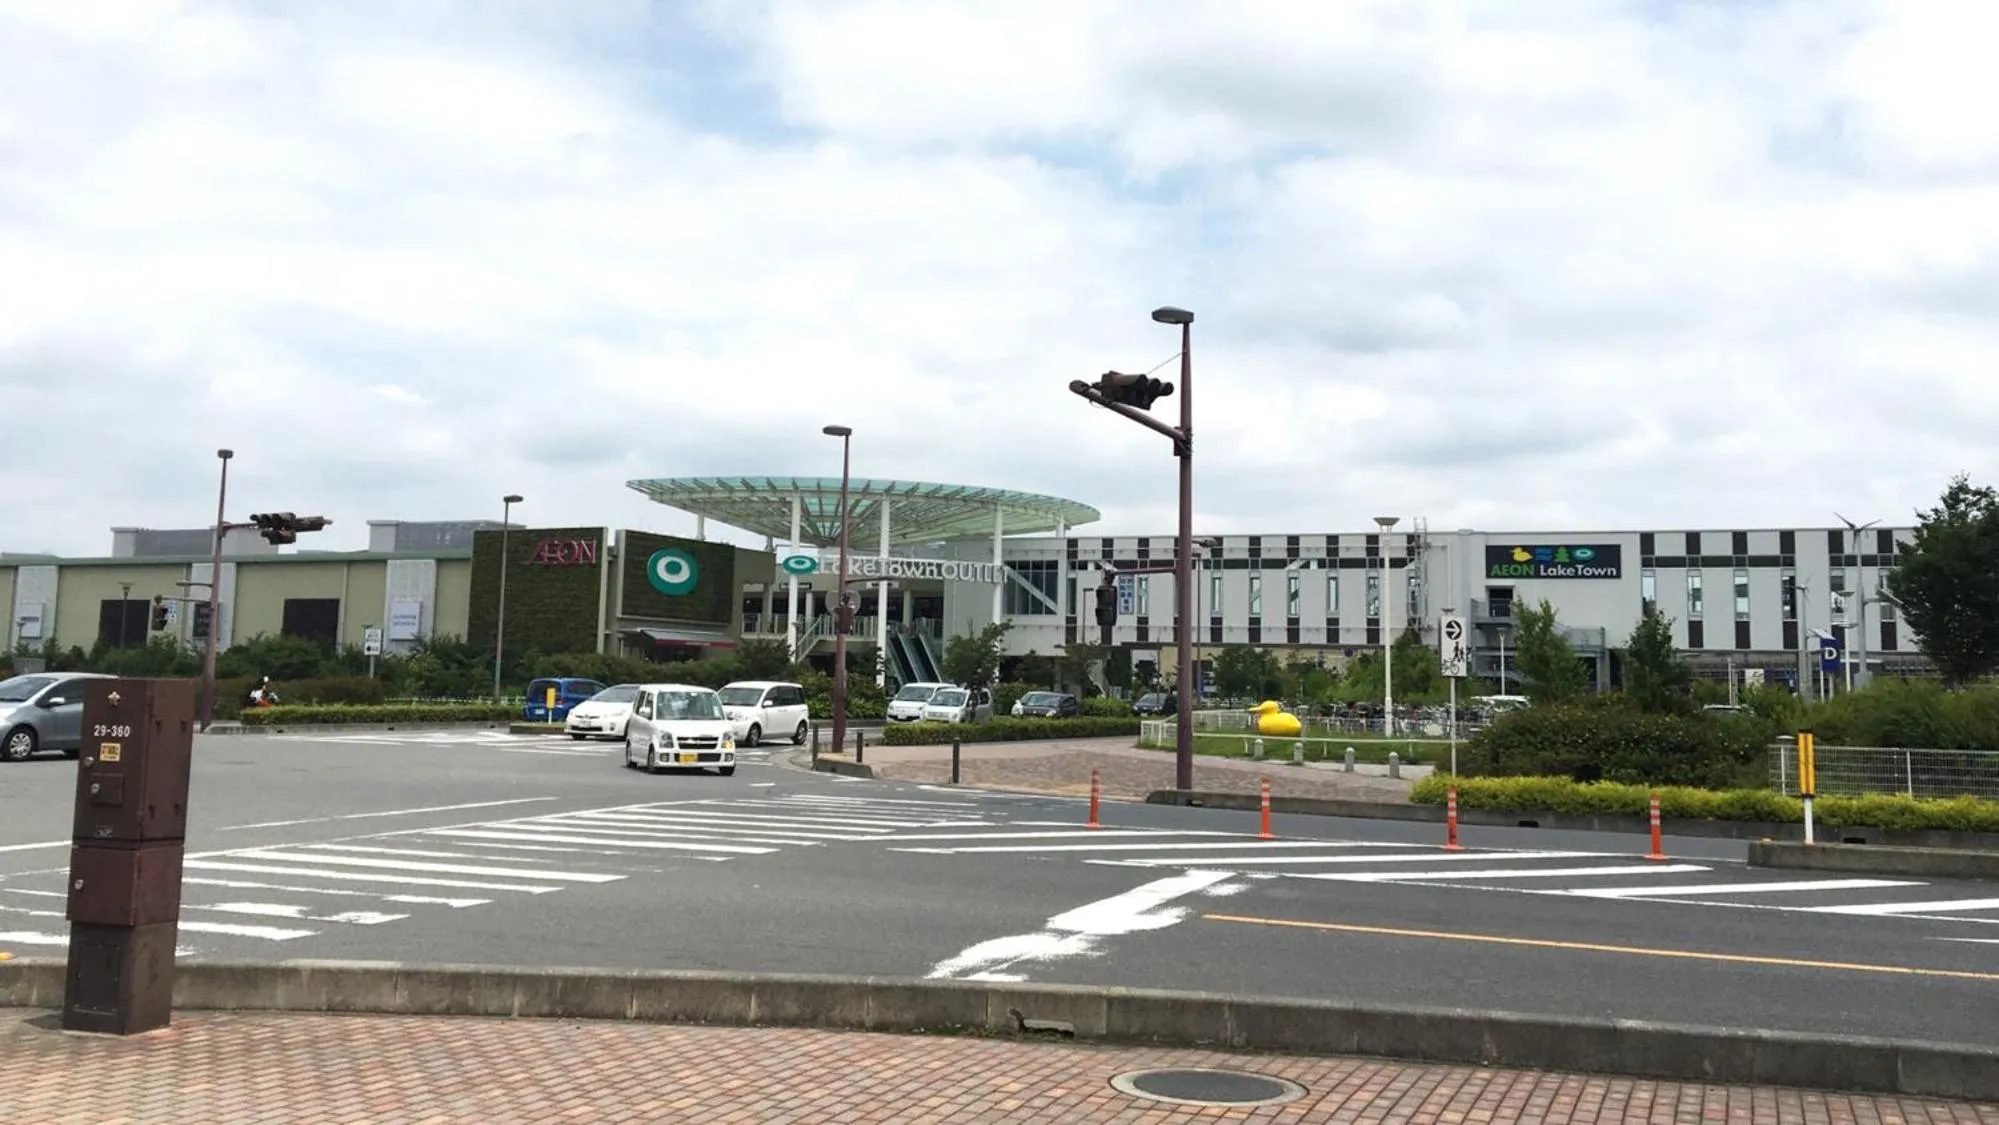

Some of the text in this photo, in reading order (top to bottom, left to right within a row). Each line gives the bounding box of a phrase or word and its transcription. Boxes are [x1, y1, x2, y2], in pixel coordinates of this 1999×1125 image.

[1491, 564, 1617, 577] AEON LakeTown
[1824, 647, 1837, 660] D
[93, 724, 131, 738] 29-360
